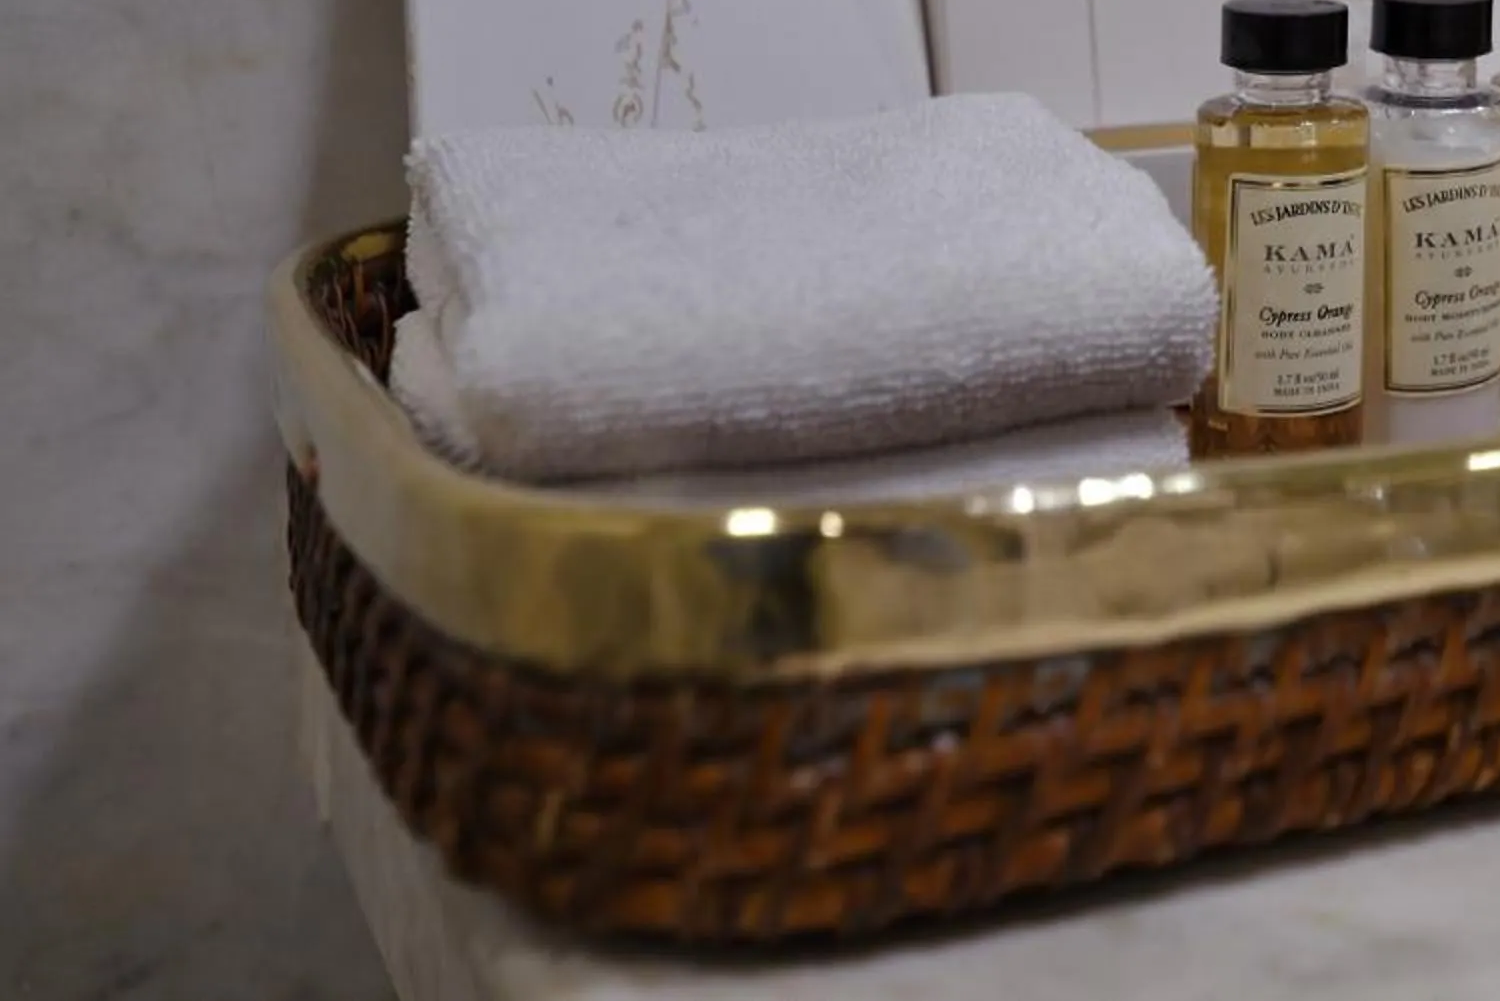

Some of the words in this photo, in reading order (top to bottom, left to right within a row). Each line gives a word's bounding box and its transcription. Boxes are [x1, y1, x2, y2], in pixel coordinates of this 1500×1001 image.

[1402, 196, 1425, 213] LES
[1426, 185, 1478, 208] JARDINS
[1250, 207, 1275, 227] LES
[1275, 201, 1331, 222] JARDINS
[1415, 222, 1499, 249] KAMA
[1263, 239, 1354, 263] KAMA
[1414, 290, 1466, 310] Cypress
[1259, 306, 1312, 327] Cypress
[1261, 330, 1294, 339] BODY
